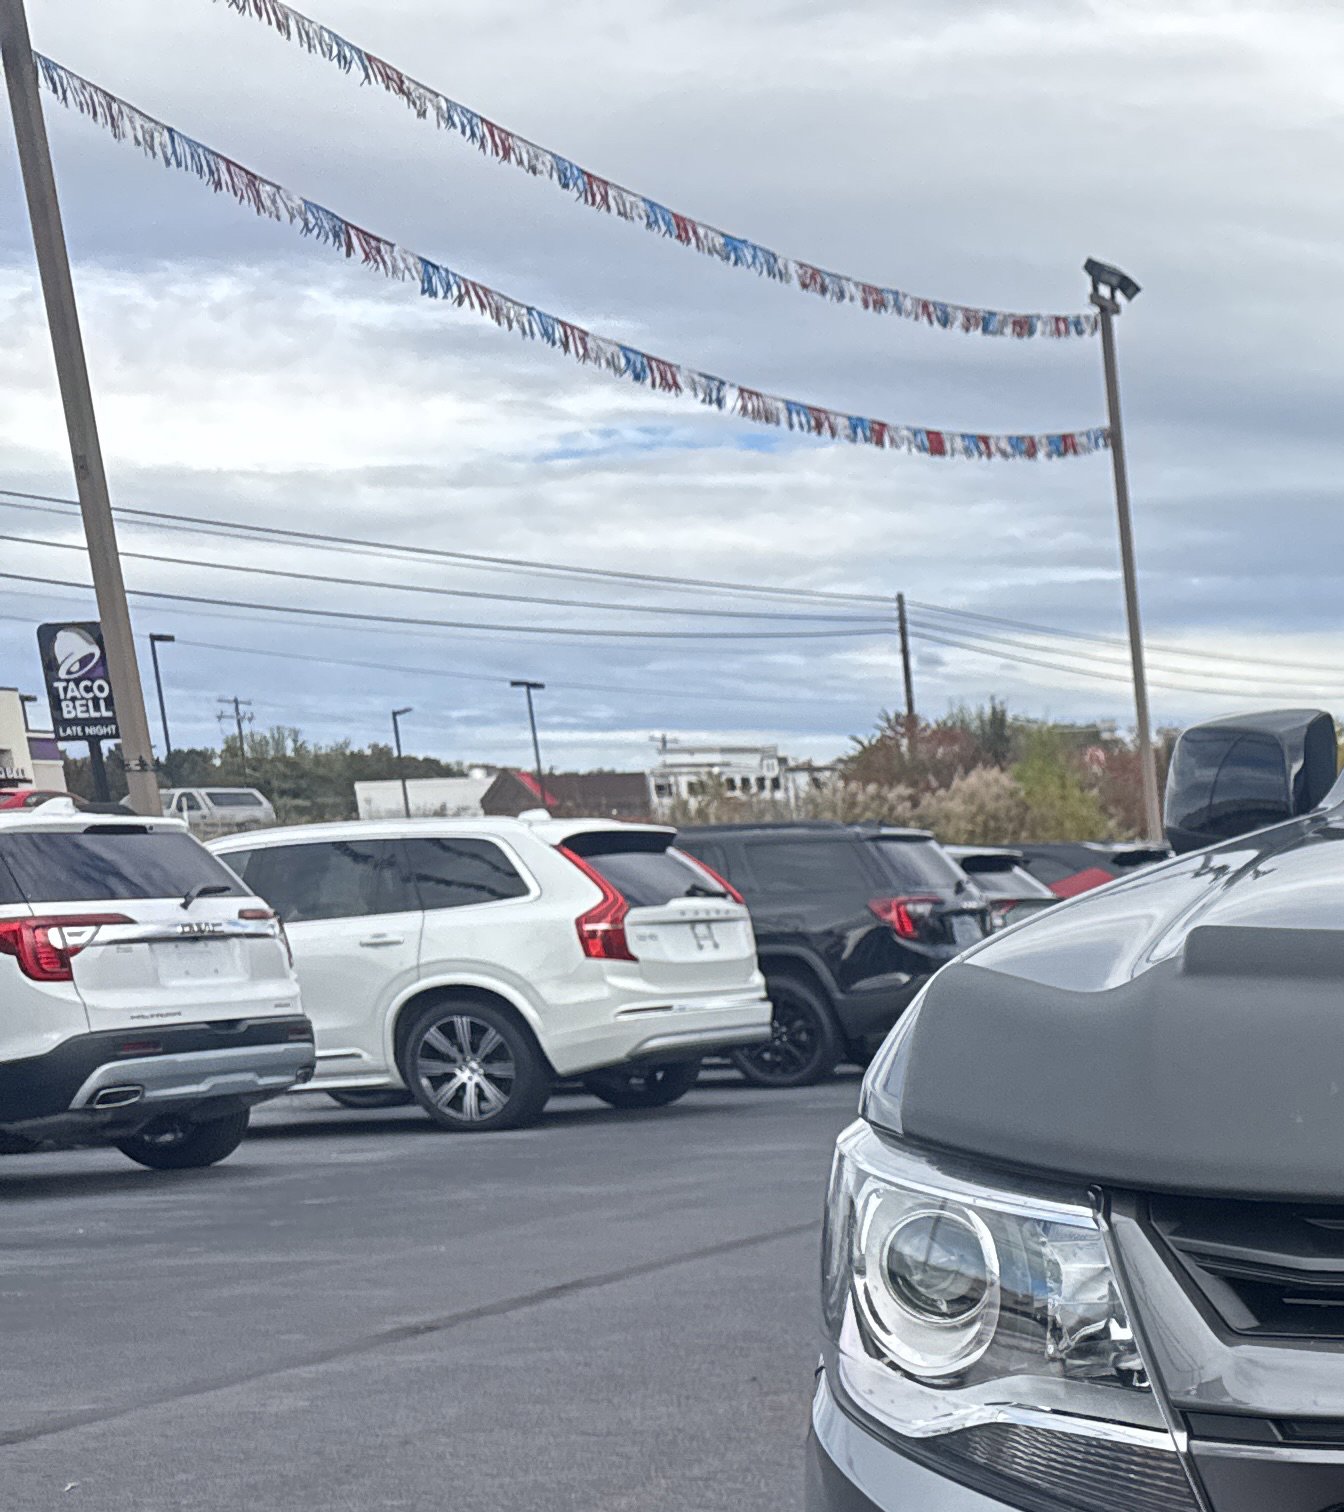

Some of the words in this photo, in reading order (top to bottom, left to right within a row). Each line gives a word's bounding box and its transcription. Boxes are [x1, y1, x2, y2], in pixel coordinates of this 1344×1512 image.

[53, 679, 110, 699] TACO
[61, 700, 113, 719] BELL
[59, 726, 84, 737] LATE
[85, 724, 117, 736] NIGHT
